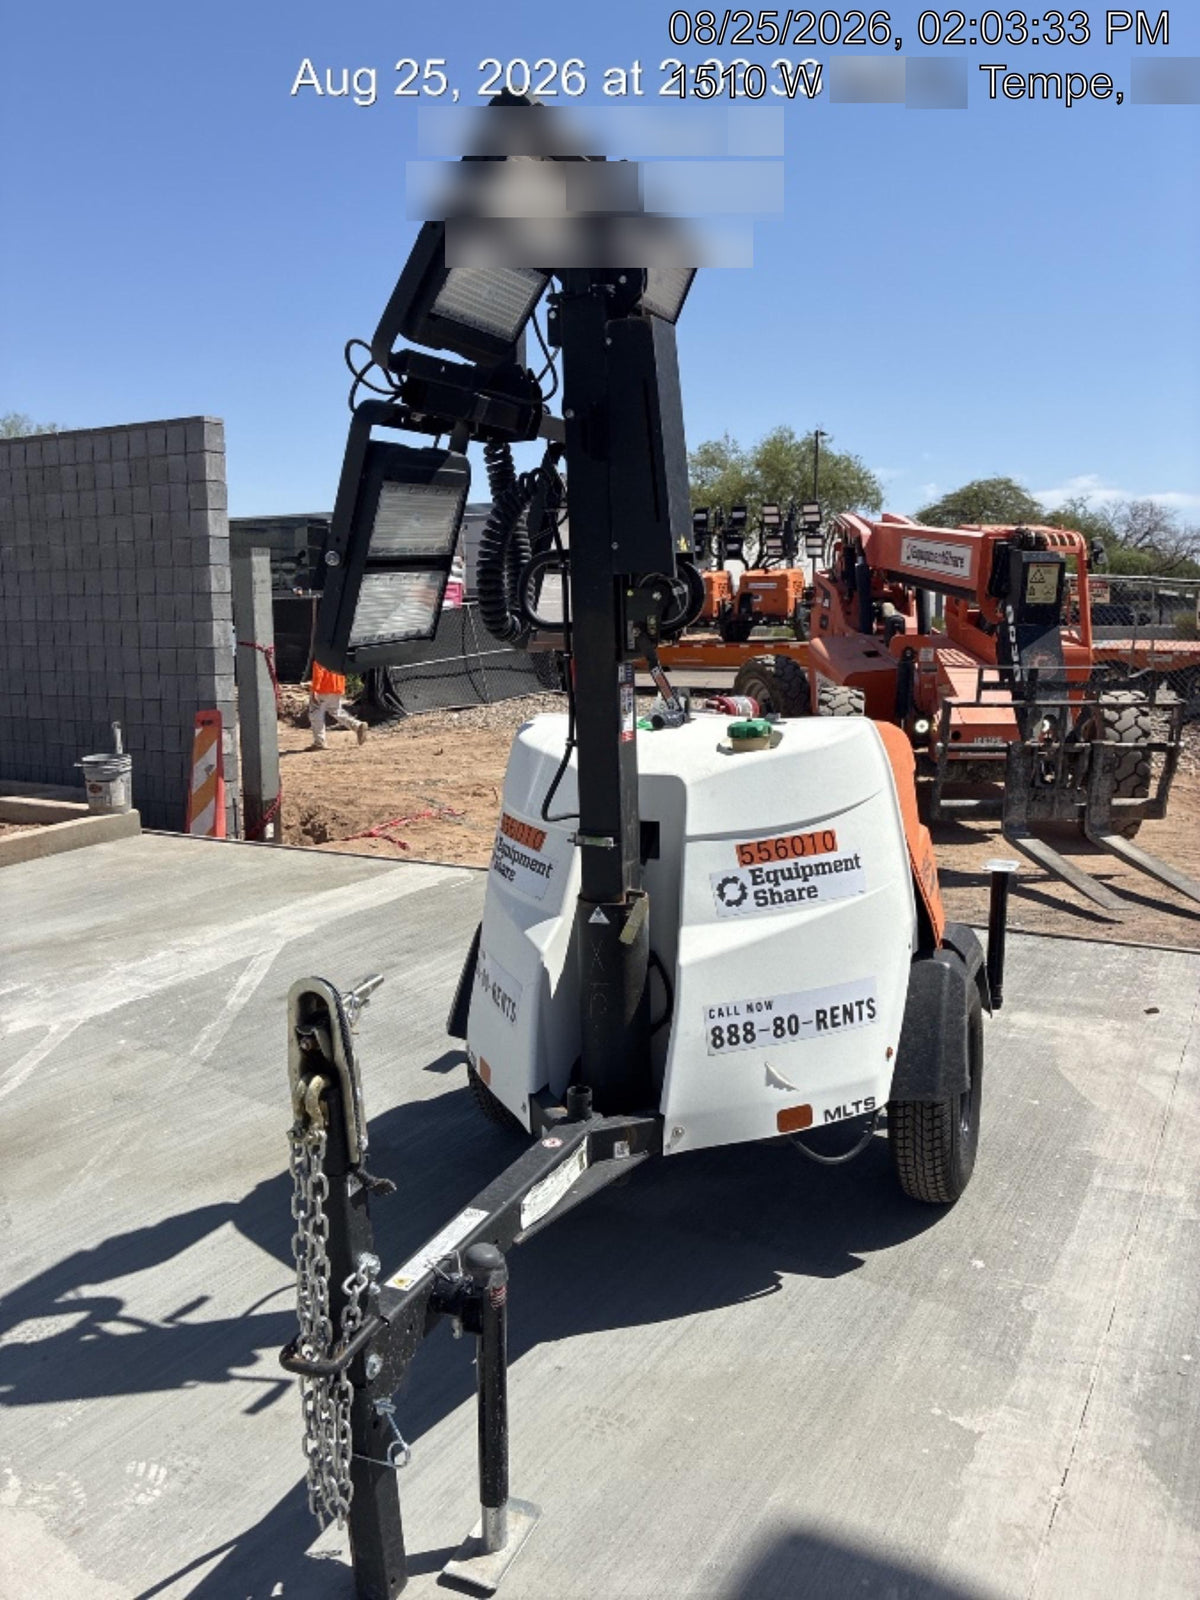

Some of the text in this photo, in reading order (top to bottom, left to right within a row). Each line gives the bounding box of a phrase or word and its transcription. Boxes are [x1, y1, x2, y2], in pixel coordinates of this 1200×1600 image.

[739, 830, 836, 866] 556010
[749, 853, 861, 887] Equipment
[753, 884, 819, 908] Share
[709, 1000, 774, 1020] CALL NOW
[711, 997, 877, 1049] 888-80-RENTS
[824, 1096, 877, 1122] MLTS
